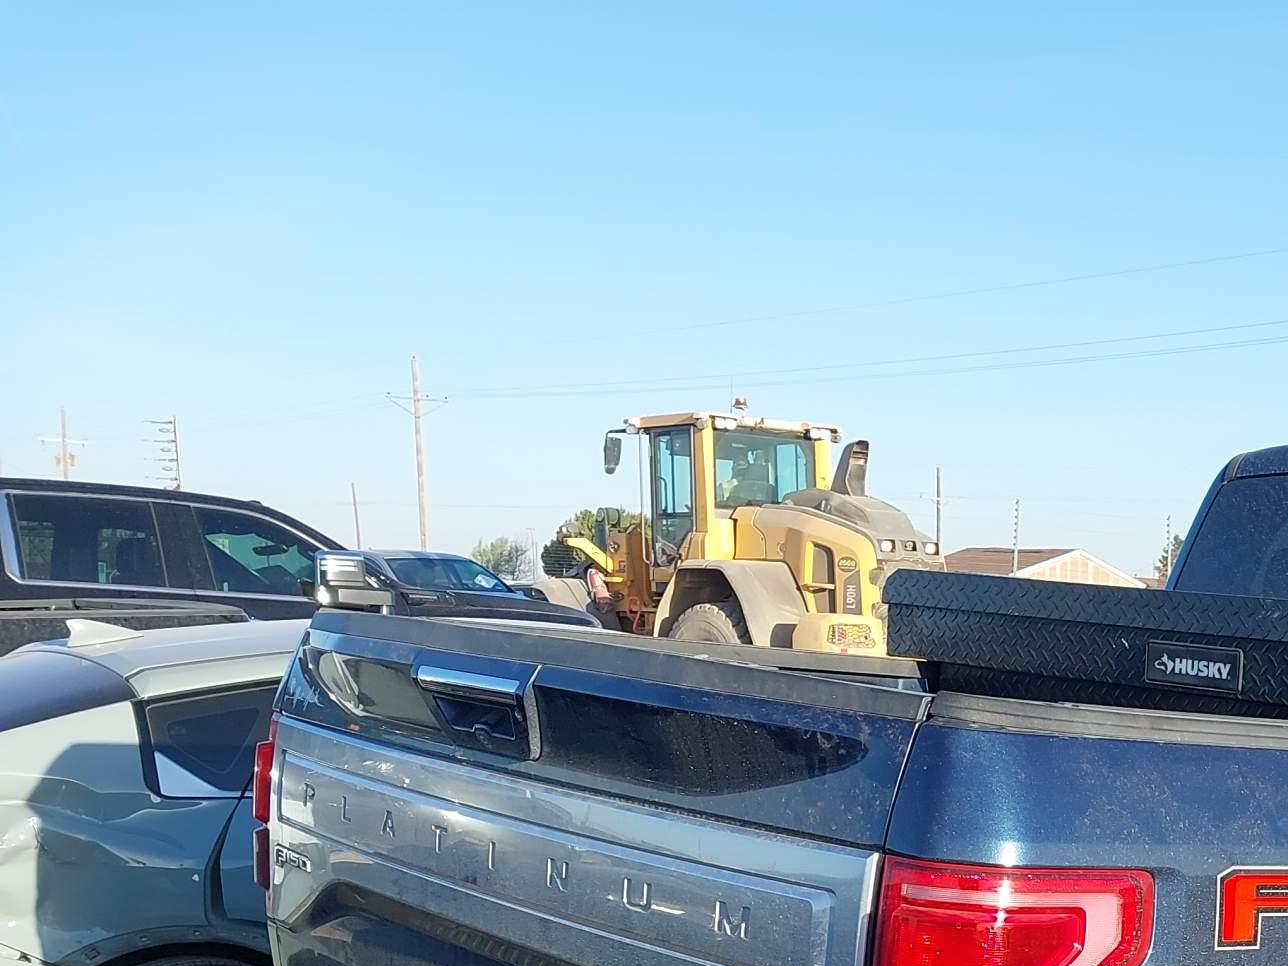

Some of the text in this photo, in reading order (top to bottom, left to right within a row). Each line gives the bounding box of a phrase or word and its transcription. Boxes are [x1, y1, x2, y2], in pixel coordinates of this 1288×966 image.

[845, 584, 857, 609] L90H
[1174, 657, 1232, 679] HUSKY
[302, 782, 752, 940] PLATINUM
